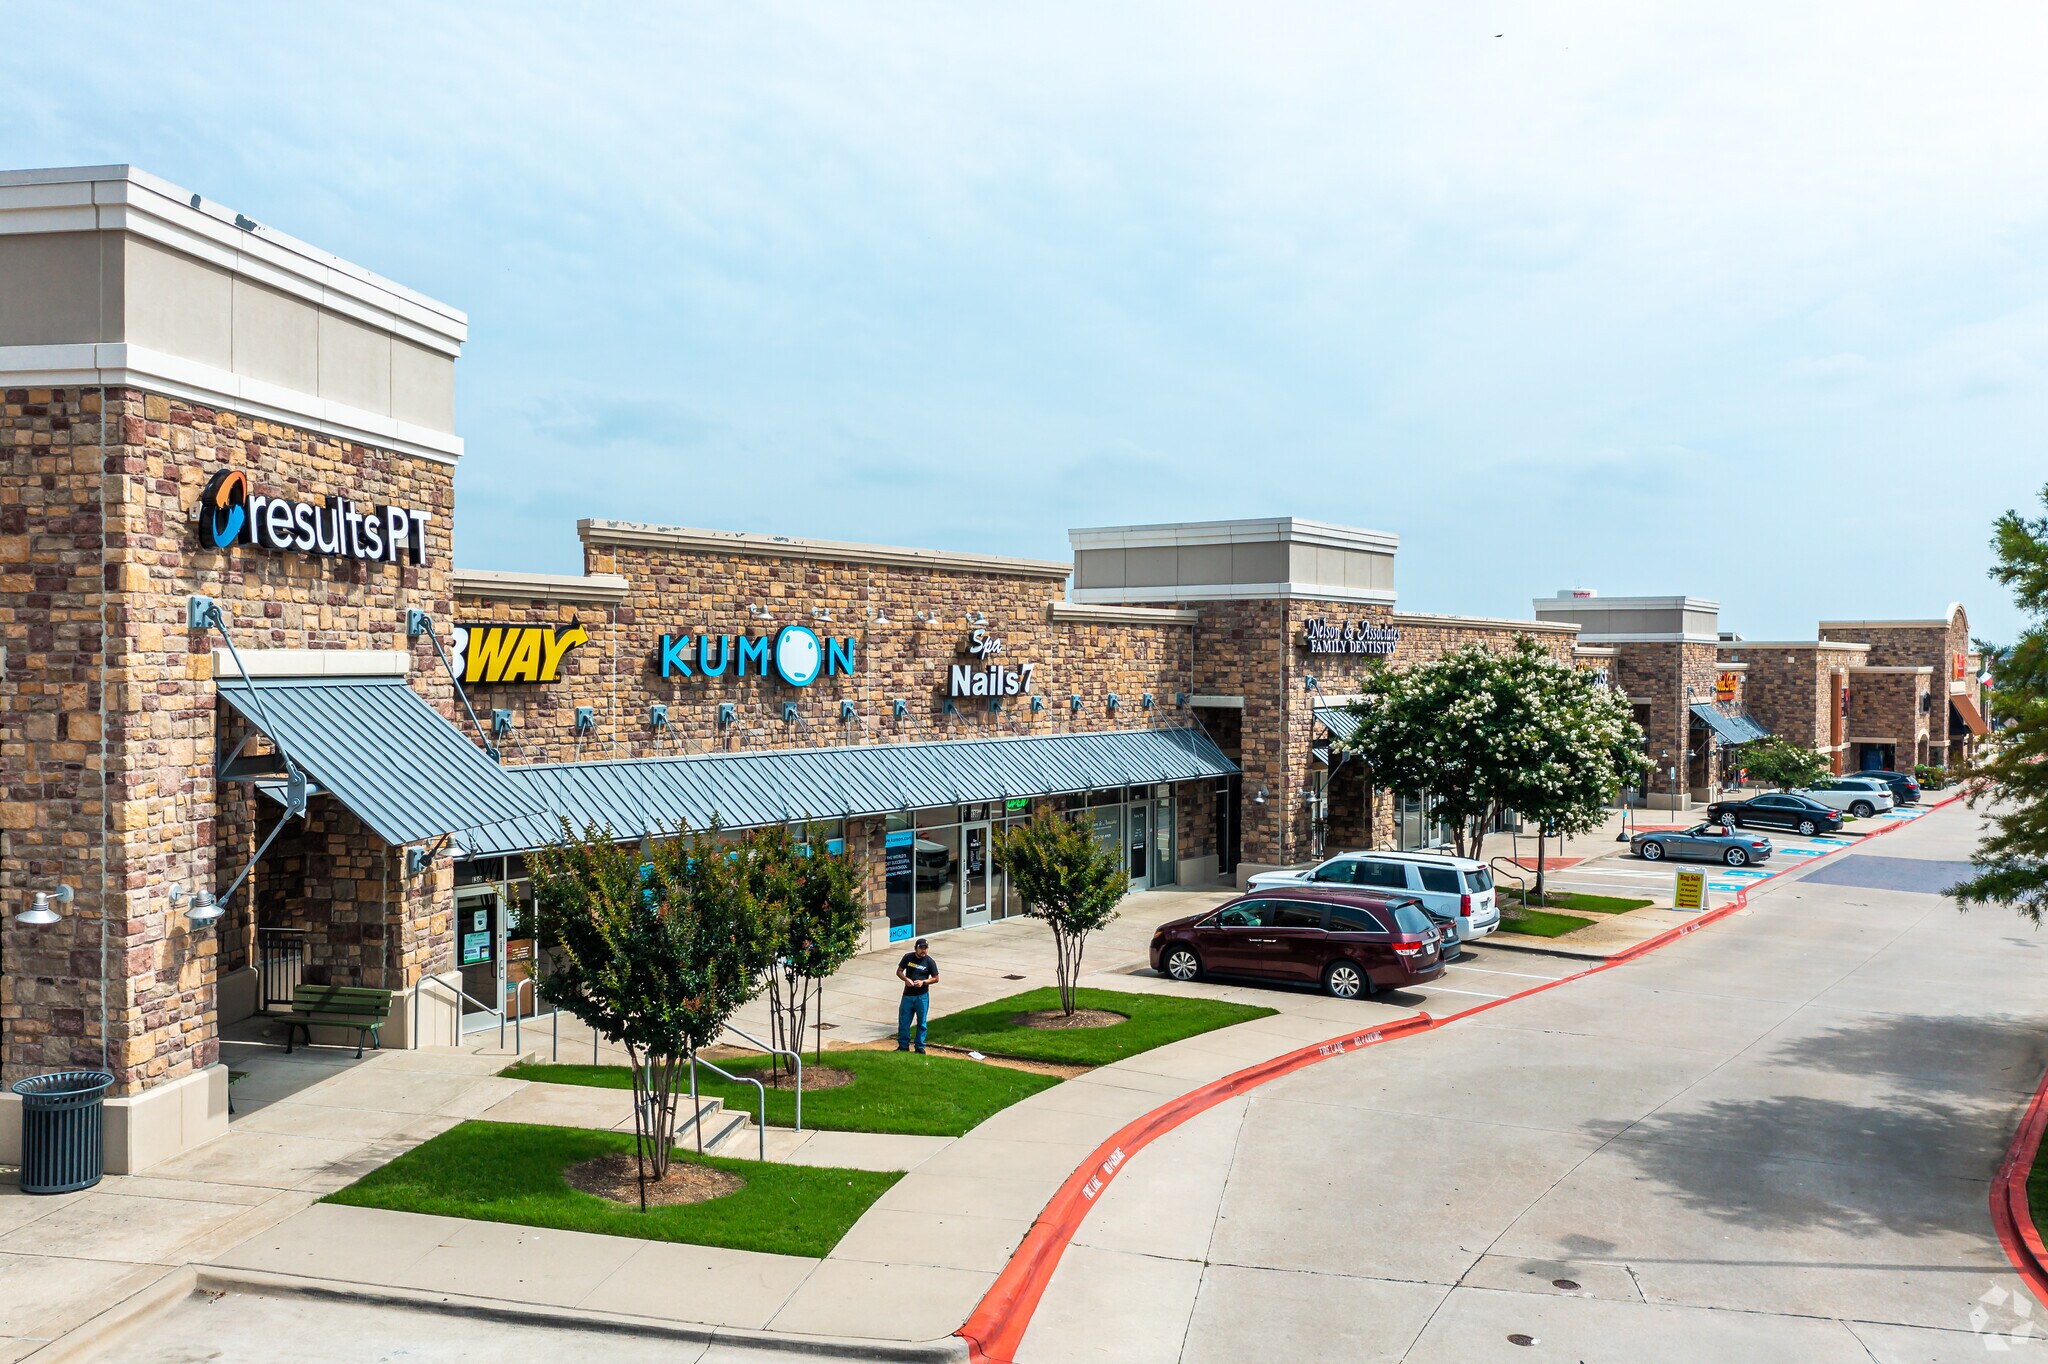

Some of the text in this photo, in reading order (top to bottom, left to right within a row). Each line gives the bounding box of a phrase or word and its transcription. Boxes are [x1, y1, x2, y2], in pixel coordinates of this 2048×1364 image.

[249, 494, 432, 565] results PT
[970, 629, 1002, 660] Spa
[1308, 617, 1400, 641] Nelson & Associates
[1311, 640, 1397, 653] FAMILY DENTISTRY
[453, 624, 589, 682] BWAY
[661, 625, 855, 687] KUMON
